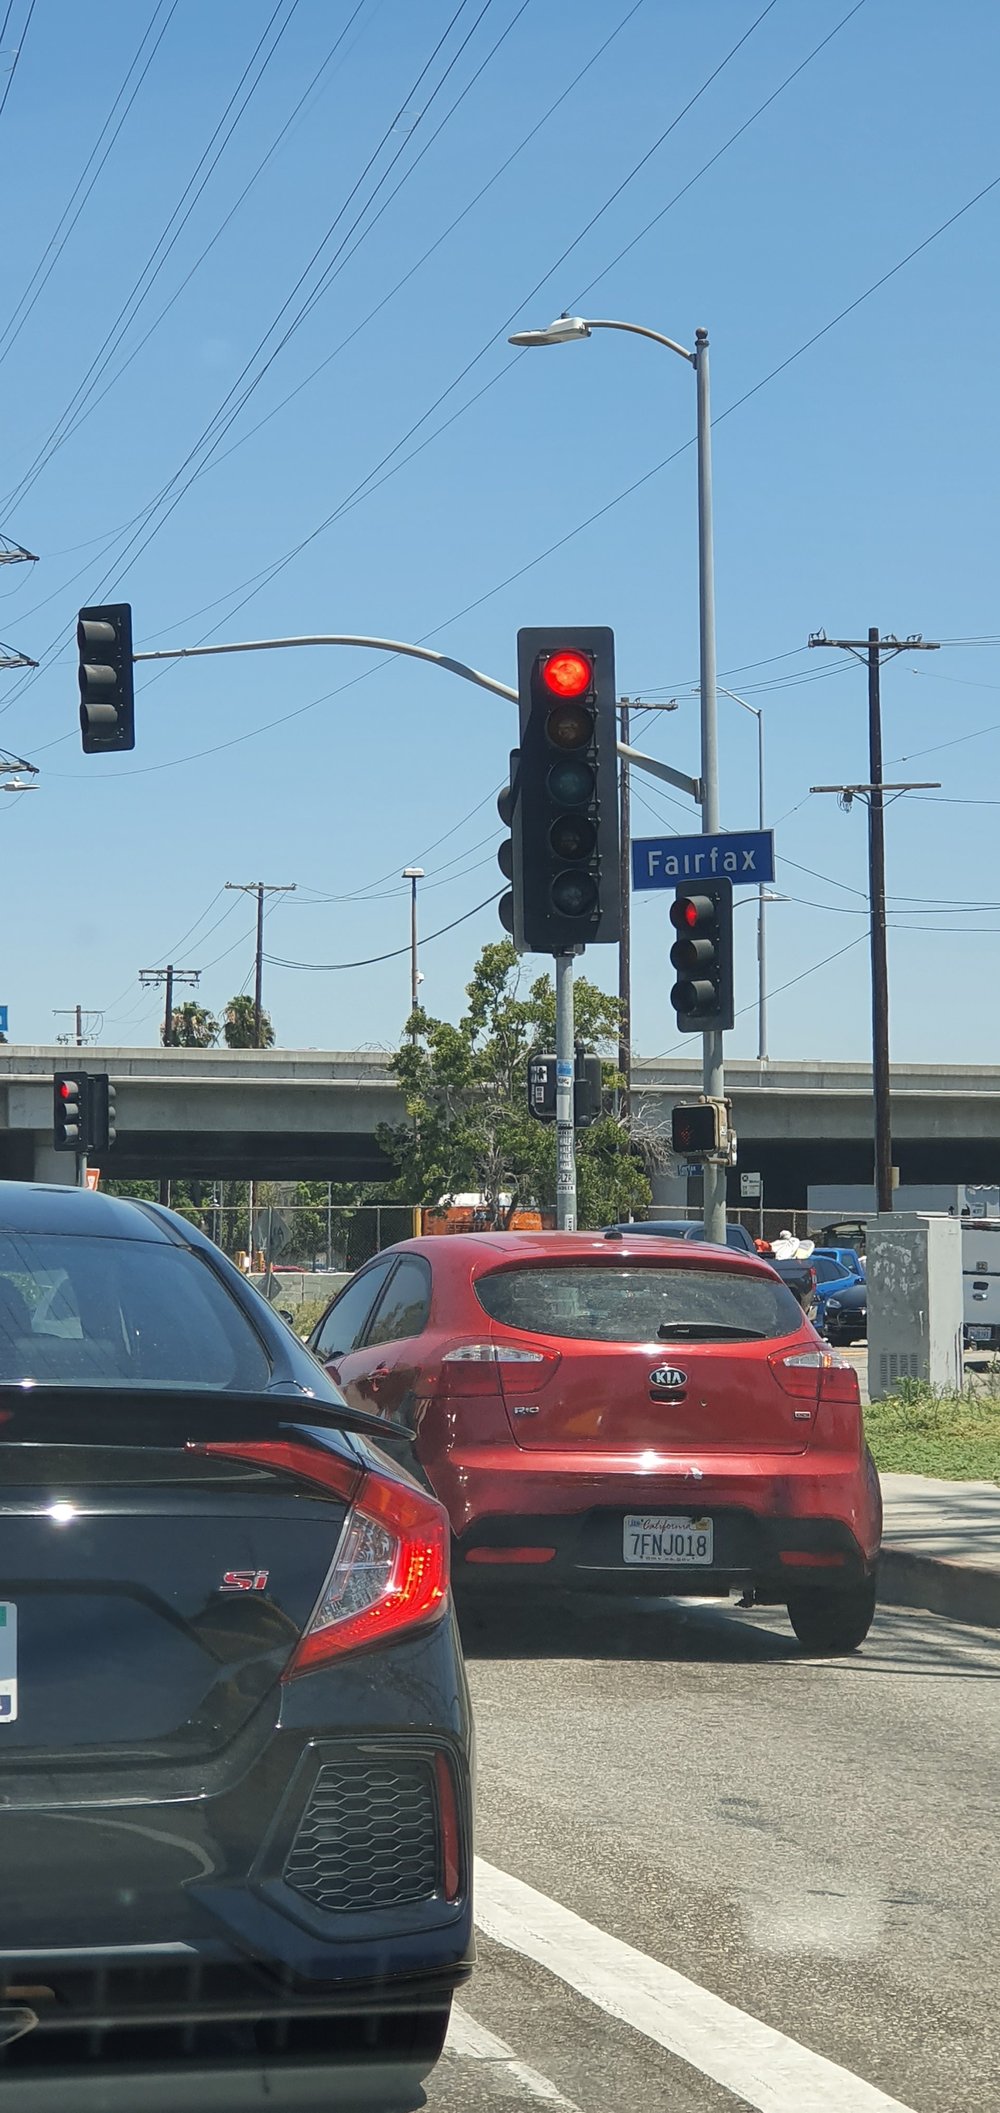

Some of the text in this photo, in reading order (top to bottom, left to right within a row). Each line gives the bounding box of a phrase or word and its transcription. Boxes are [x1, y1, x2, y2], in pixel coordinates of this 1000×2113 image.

[648, 847, 756, 877] Fairfax
[655, 1371, 682, 1384] KIA
[642, 1518, 692, 1533] California
[630, 1533, 707, 1557] 7FNJ018
[219, 1571, 270, 1592] Si
